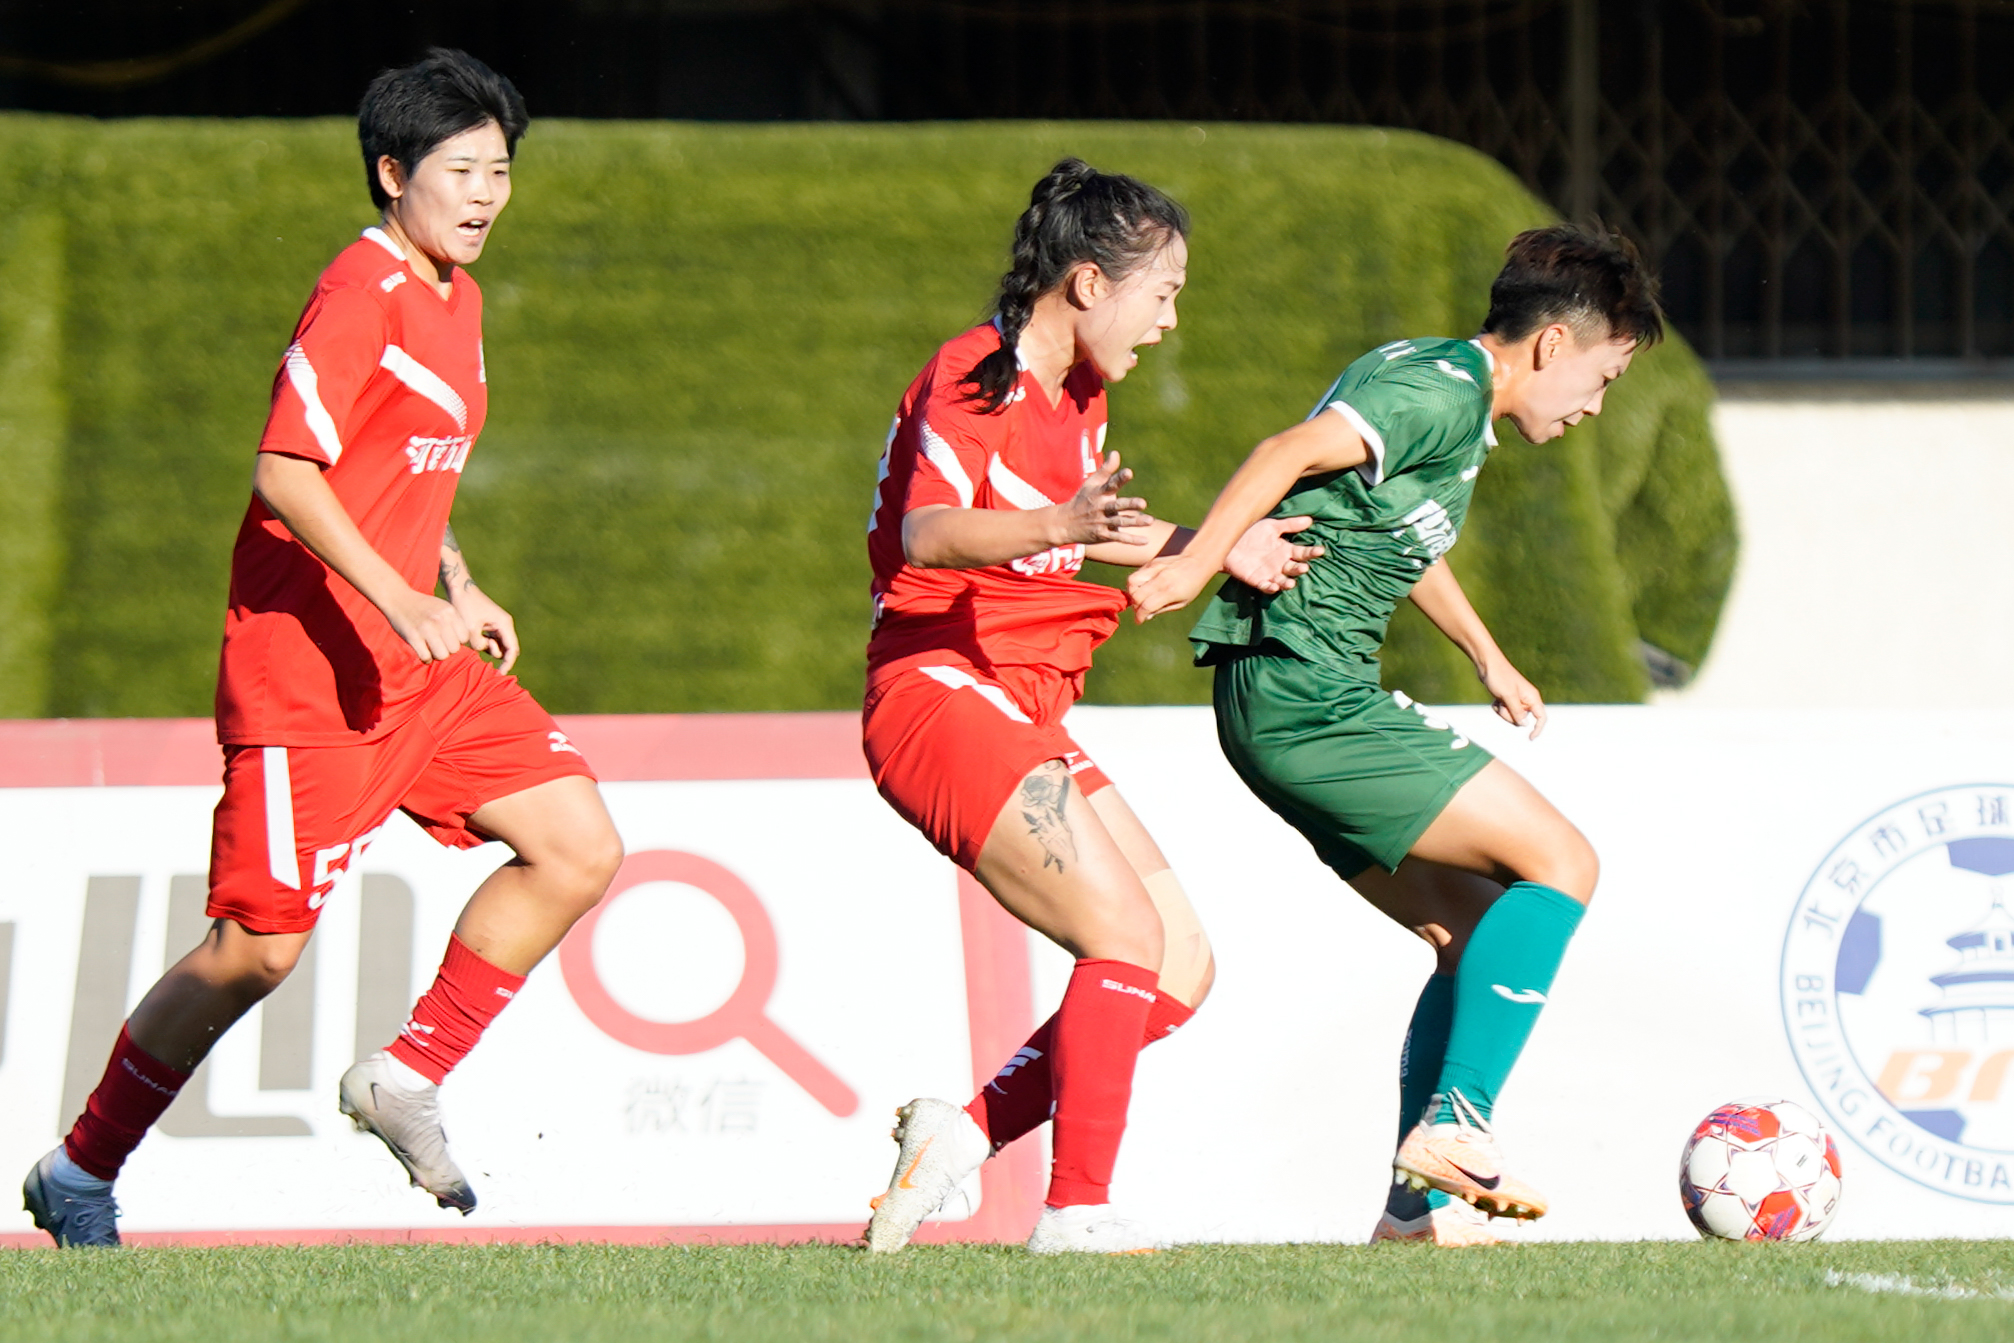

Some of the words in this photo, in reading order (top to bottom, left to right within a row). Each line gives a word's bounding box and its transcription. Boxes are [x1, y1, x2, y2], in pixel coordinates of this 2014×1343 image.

[621, 1074, 769, 1135] 微信
[1795, 974, 1869, 1116] BEIJING
[1866, 1114, 2012, 1190] FOOTBA
